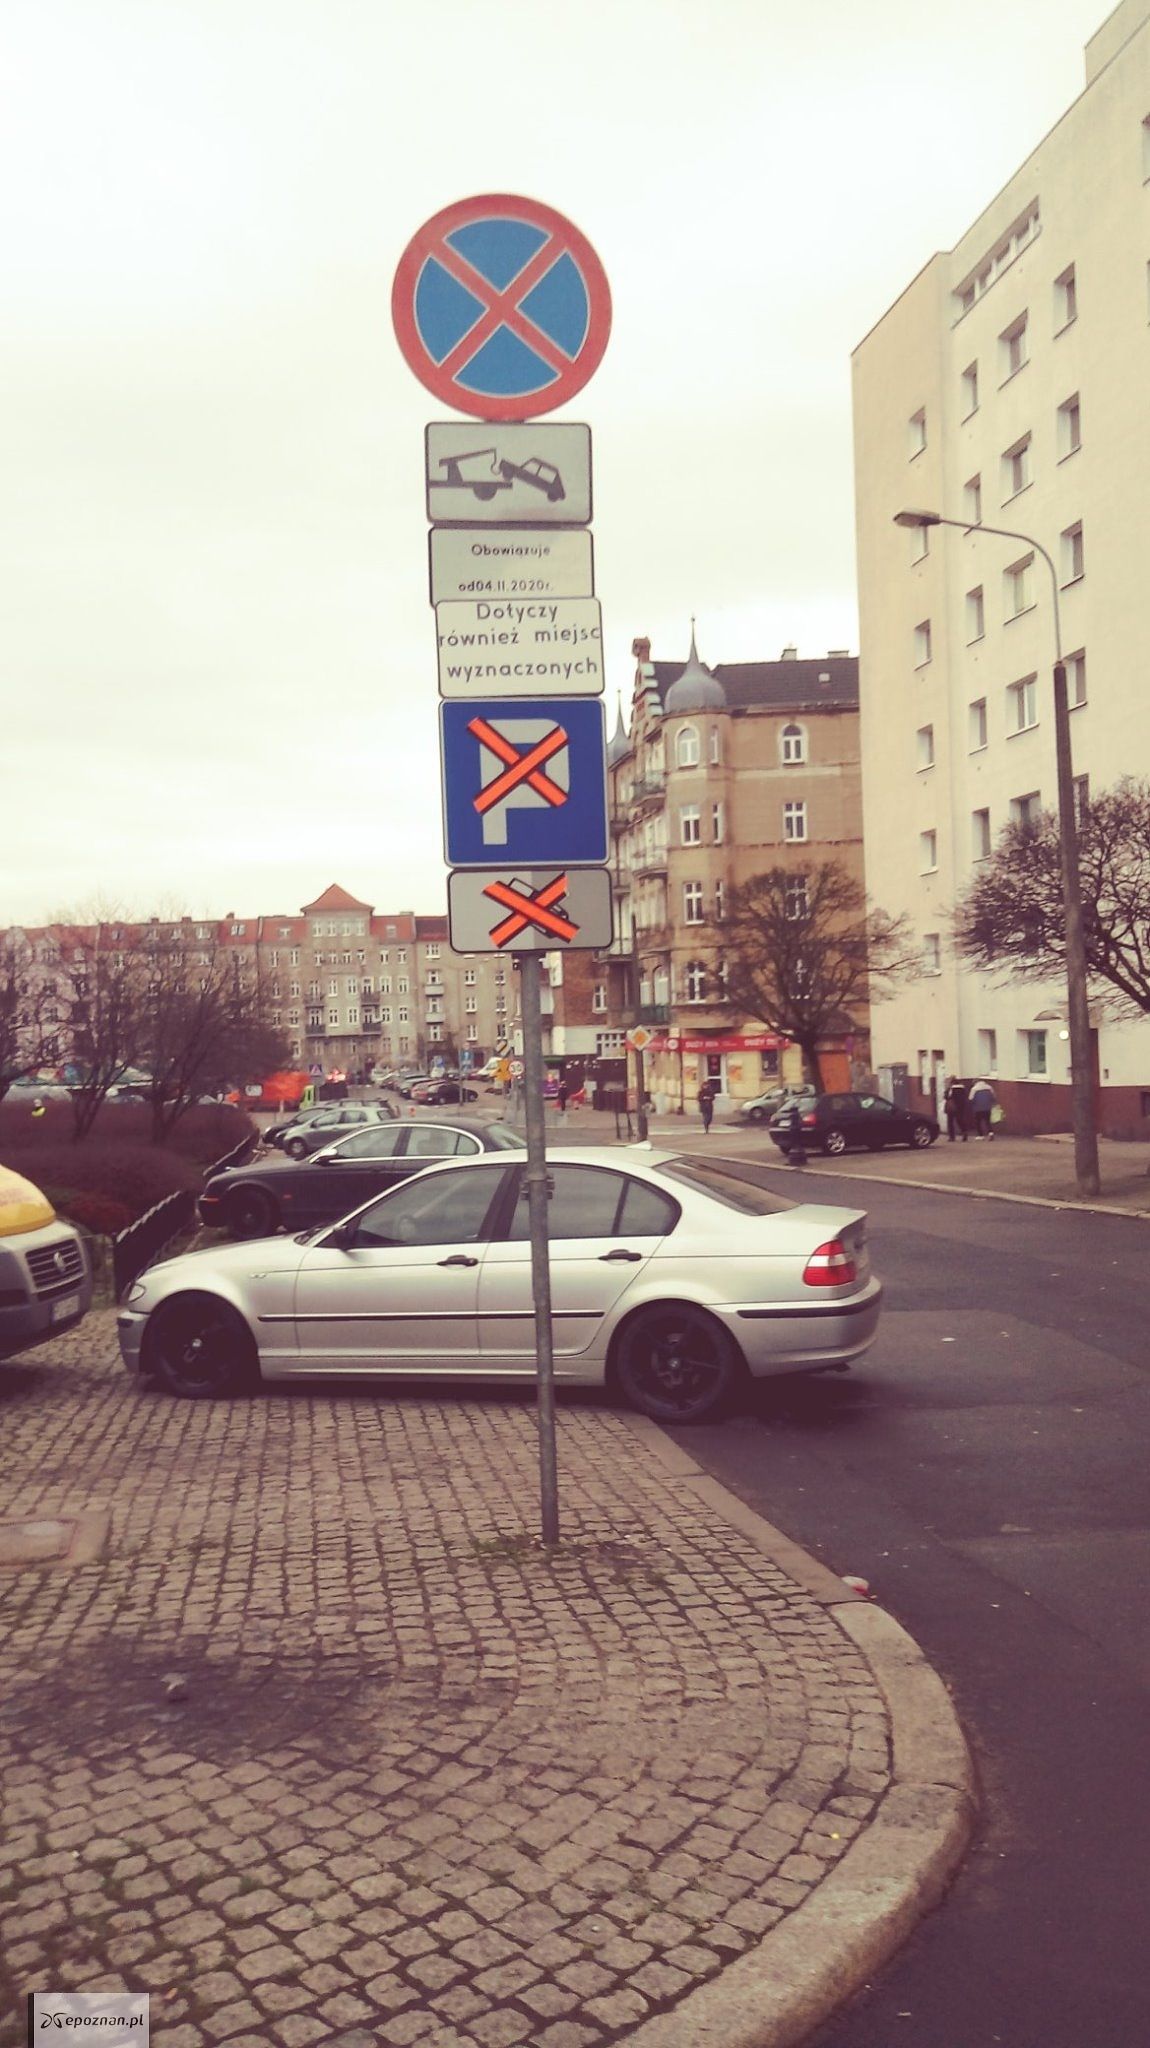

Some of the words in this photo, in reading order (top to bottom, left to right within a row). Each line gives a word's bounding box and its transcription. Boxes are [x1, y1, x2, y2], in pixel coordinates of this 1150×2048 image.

[476, 603, 558, 623] Dotyczy
[438, 627, 520, 648] również
[535, 624, 600, 645] miejsc
[447, 657, 598, 683] wyznaczonych
[479, 718, 570, 845] P
